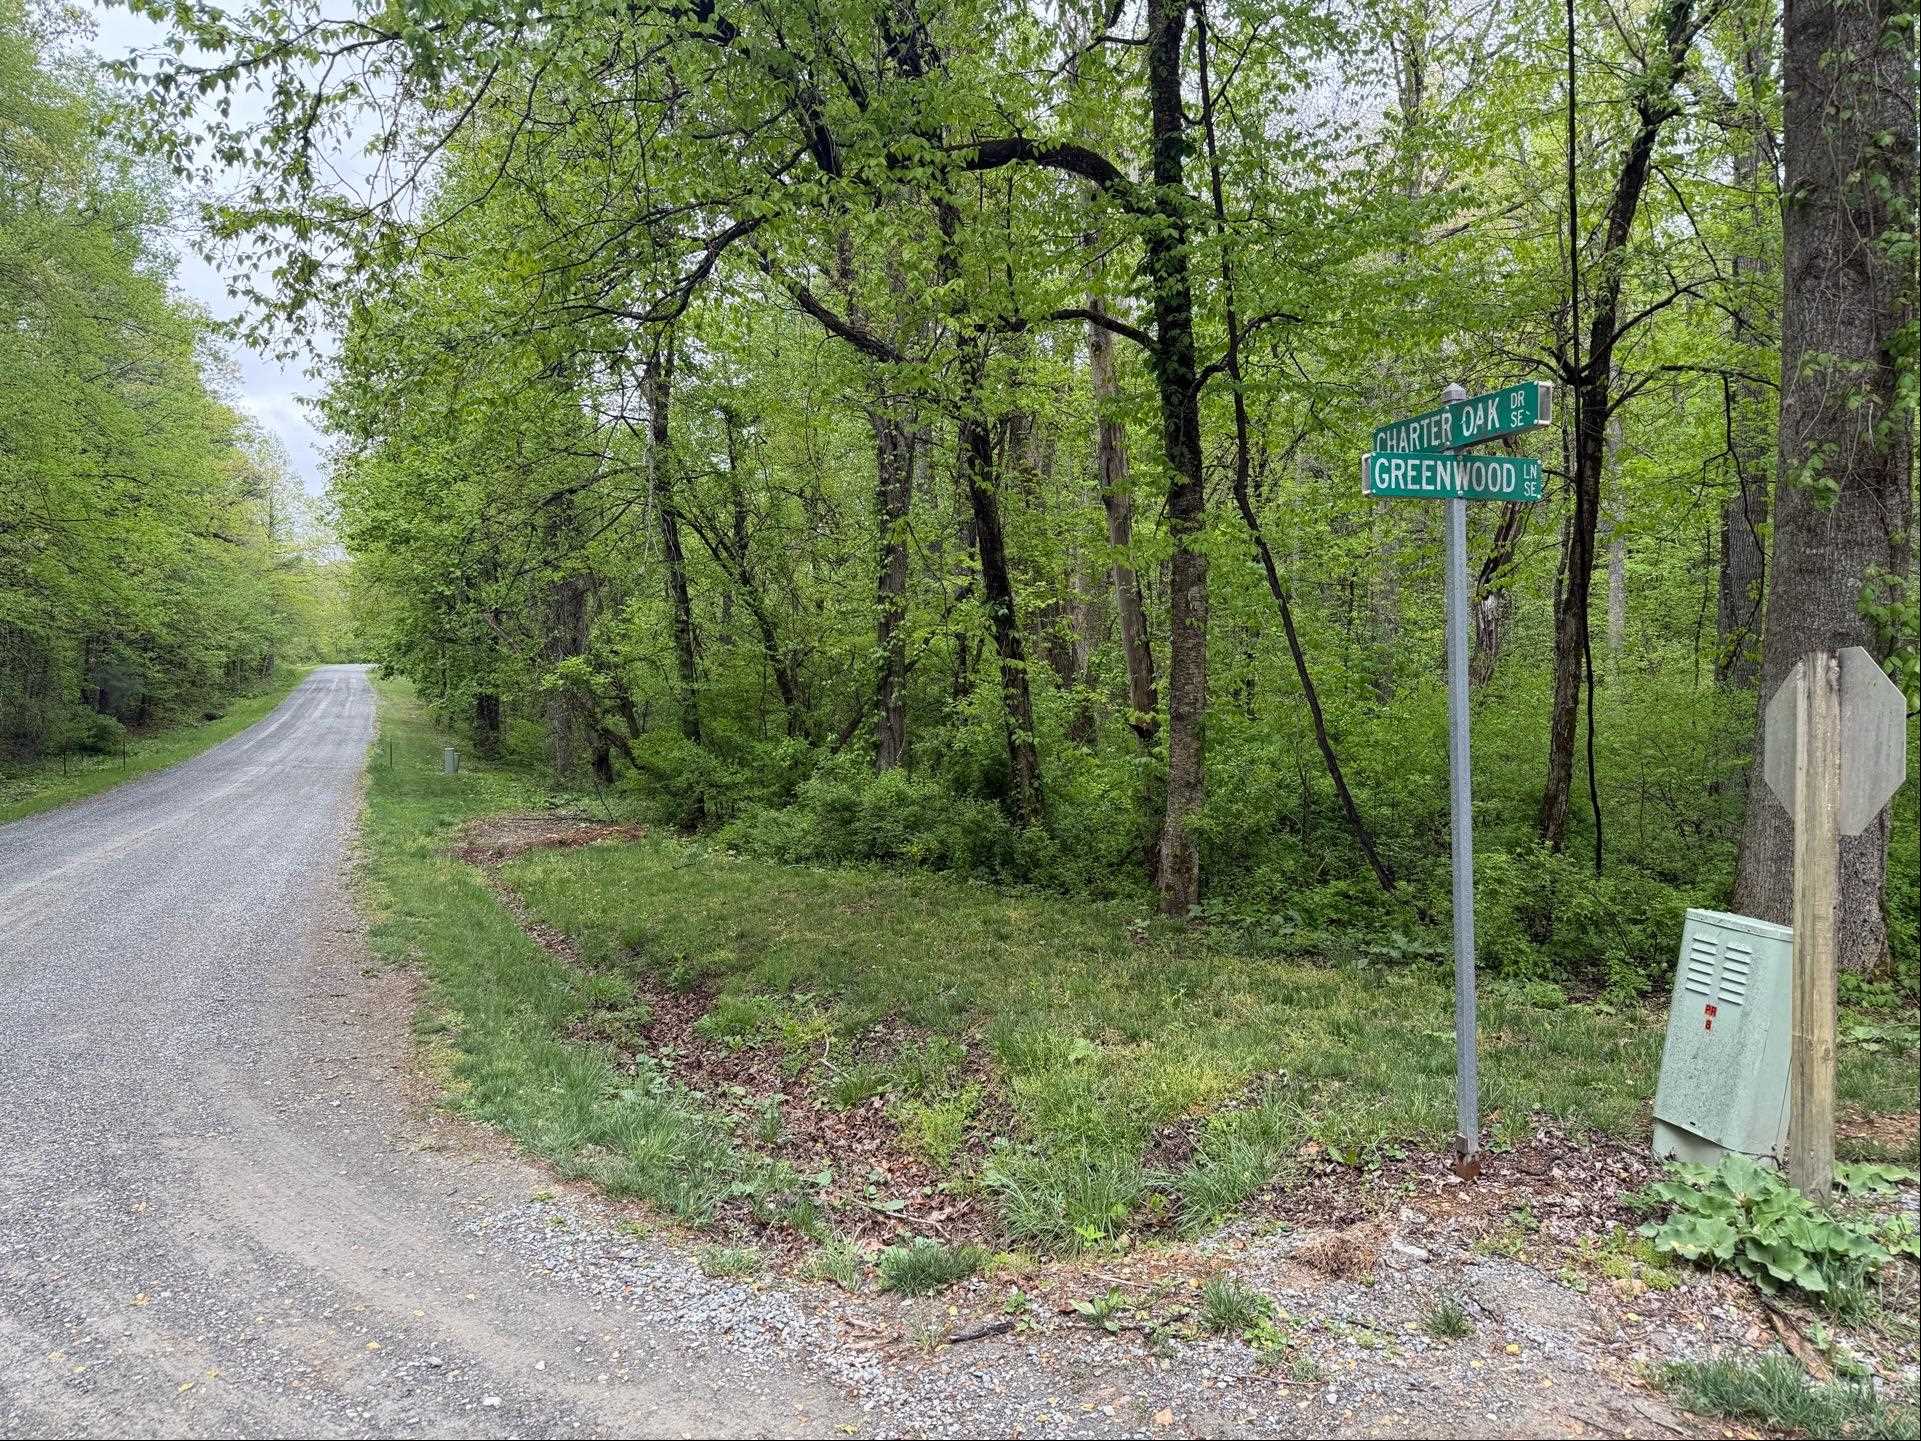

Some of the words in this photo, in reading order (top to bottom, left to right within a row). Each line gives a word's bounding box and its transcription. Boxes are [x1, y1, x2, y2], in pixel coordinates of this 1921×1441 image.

[1510, 390, 1525, 409] DR
[1377, 412, 1453, 453] CHARTER
[1462, 398, 1500, 437] OAK
[1510, 410, 1525, 428] SE
[1375, 458, 1516, 492] GREENWOOD
[1524, 464, 1537, 479] LN
[1524, 482, 1537, 496] SE
